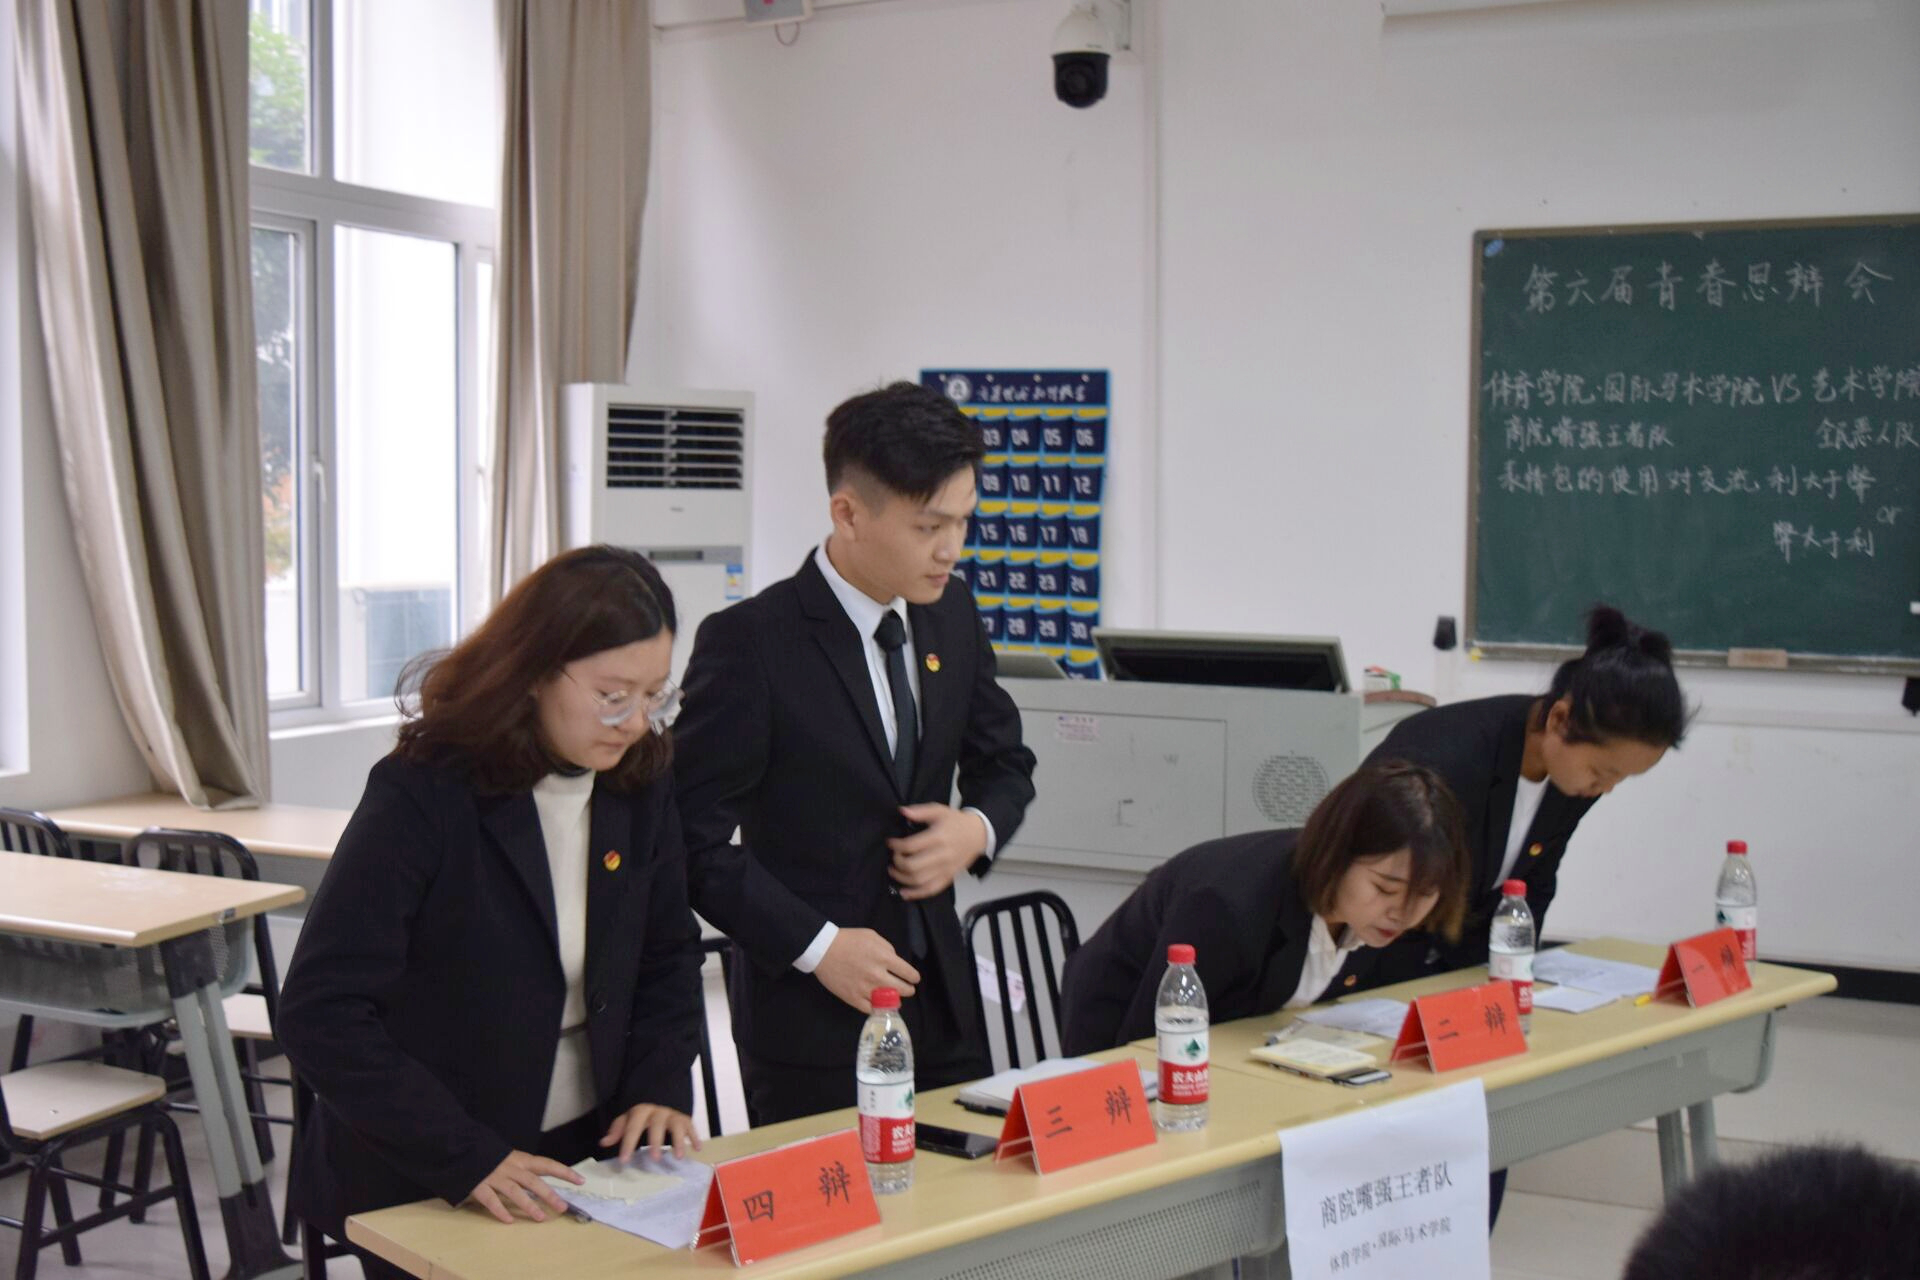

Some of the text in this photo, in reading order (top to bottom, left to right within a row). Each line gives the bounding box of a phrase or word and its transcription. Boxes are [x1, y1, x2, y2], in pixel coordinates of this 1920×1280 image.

[1771, 373, 1801, 404] VS
[1812, 365, 1920, 403] 艺术学院
[983, 428, 1094, 447] 03 04 05 06
[1012, 473, 1031, 492] 10
[1042, 474, 1061, 493] 11
[1073, 475, 1092, 494] 12
[979, 522, 1089, 544] 15 16 17 18
[979, 570, 997, 588] 21
[1008, 571, 1028, 589] 22
[1038, 573, 1057, 591] 23
[1070, 575, 1088, 593] 24
[1007, 617, 1027, 635] 28
[1038, 619, 1057, 637] 29
[1070, 621, 1089, 640] 30
[1319, 1160, 1453, 1229] 商院嘴强王者队
